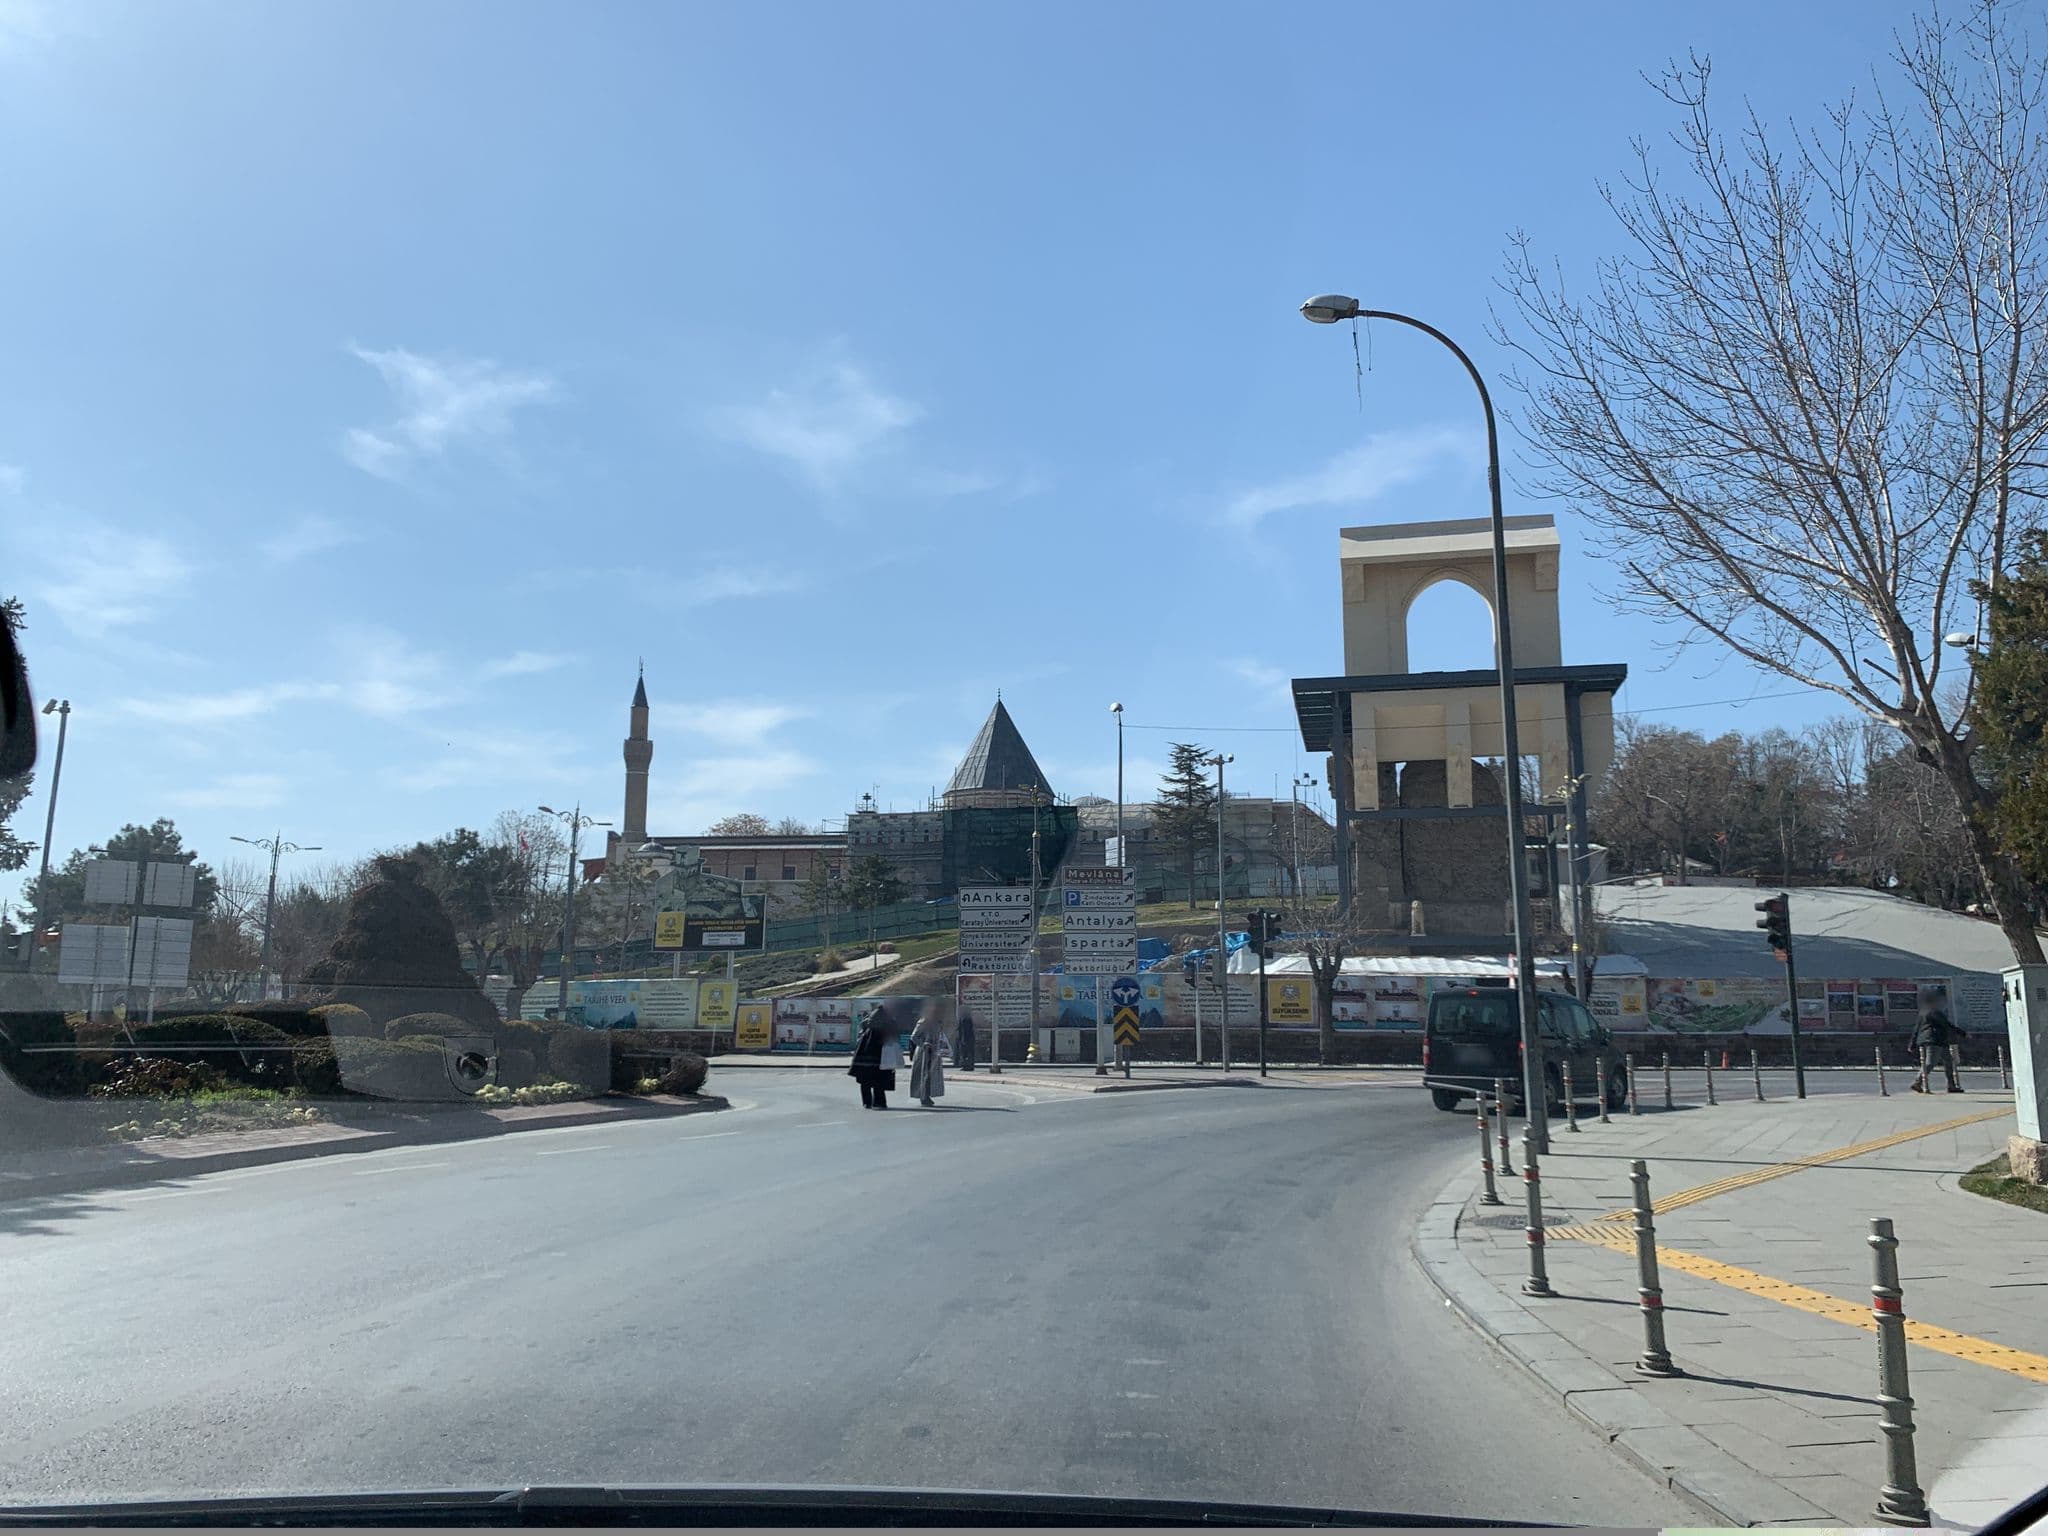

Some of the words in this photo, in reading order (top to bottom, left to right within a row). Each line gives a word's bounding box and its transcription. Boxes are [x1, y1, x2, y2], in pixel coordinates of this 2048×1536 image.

[1068, 869, 1120, 878] Mevlâna
[972, 892, 1030, 903] Ankara
[1068, 892, 1078, 905] P
[1065, 914, 1124, 928] Antalya
[961, 940, 1021, 948] Üniversitesi
[1065, 937, 1124, 950] Isparta
[1065, 964, 1125, 973] Rektörlüğü
